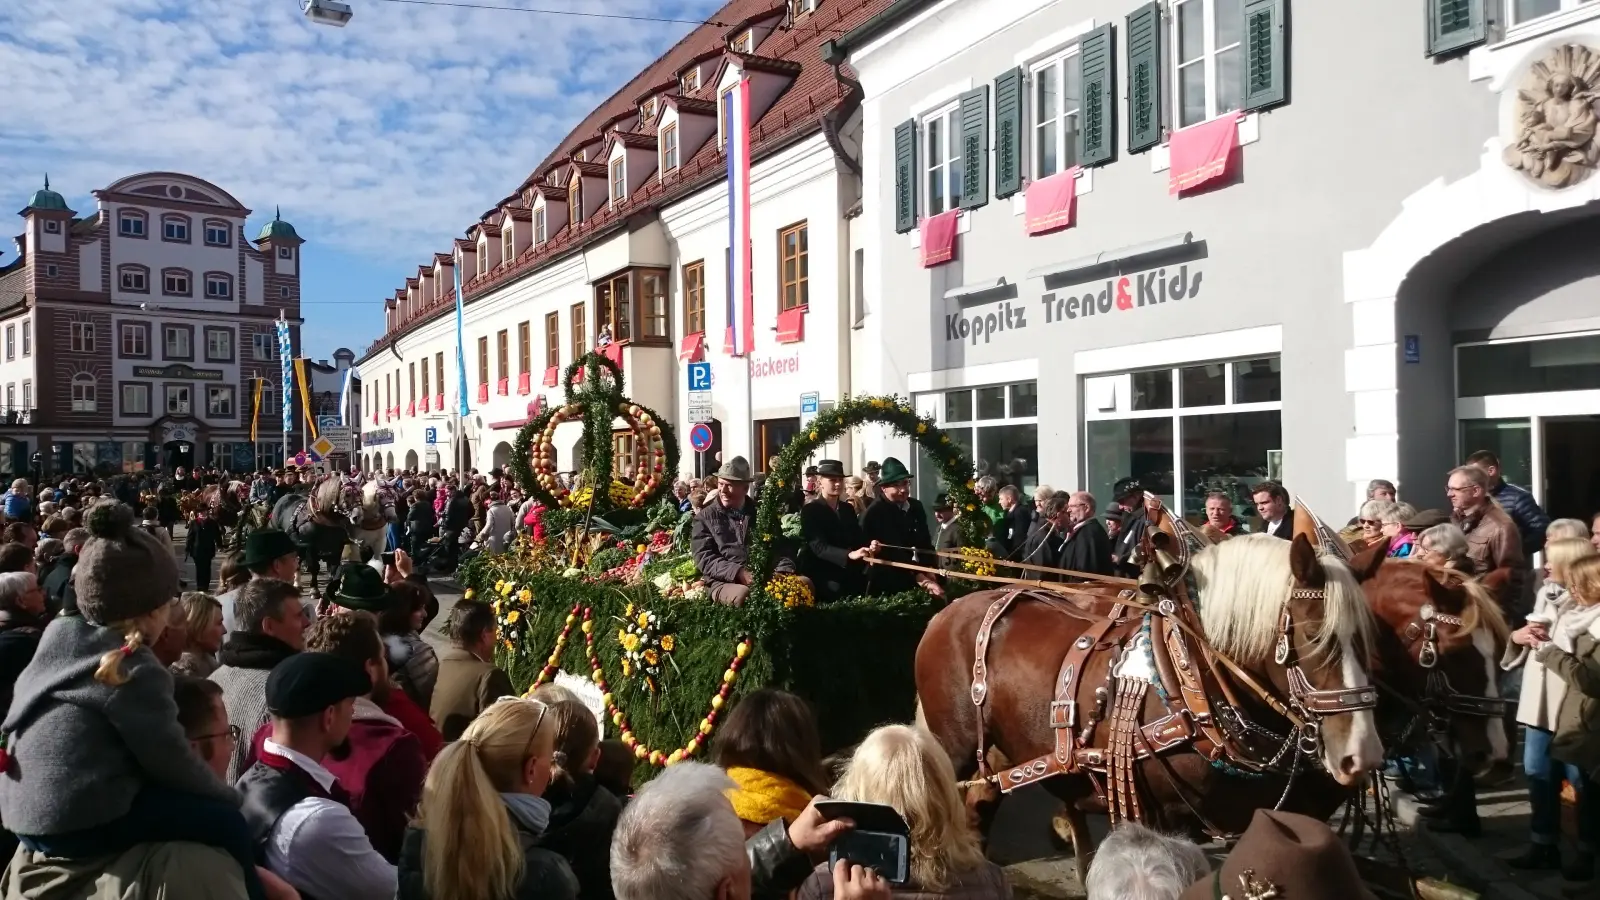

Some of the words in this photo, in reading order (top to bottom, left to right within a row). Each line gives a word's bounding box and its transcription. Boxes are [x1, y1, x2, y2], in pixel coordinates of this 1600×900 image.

[945, 302, 1027, 346] Koppitz
[693, 366, 706, 388] P
[749, 351, 799, 379] Bäckerei
[427, 429, 434, 442] P
